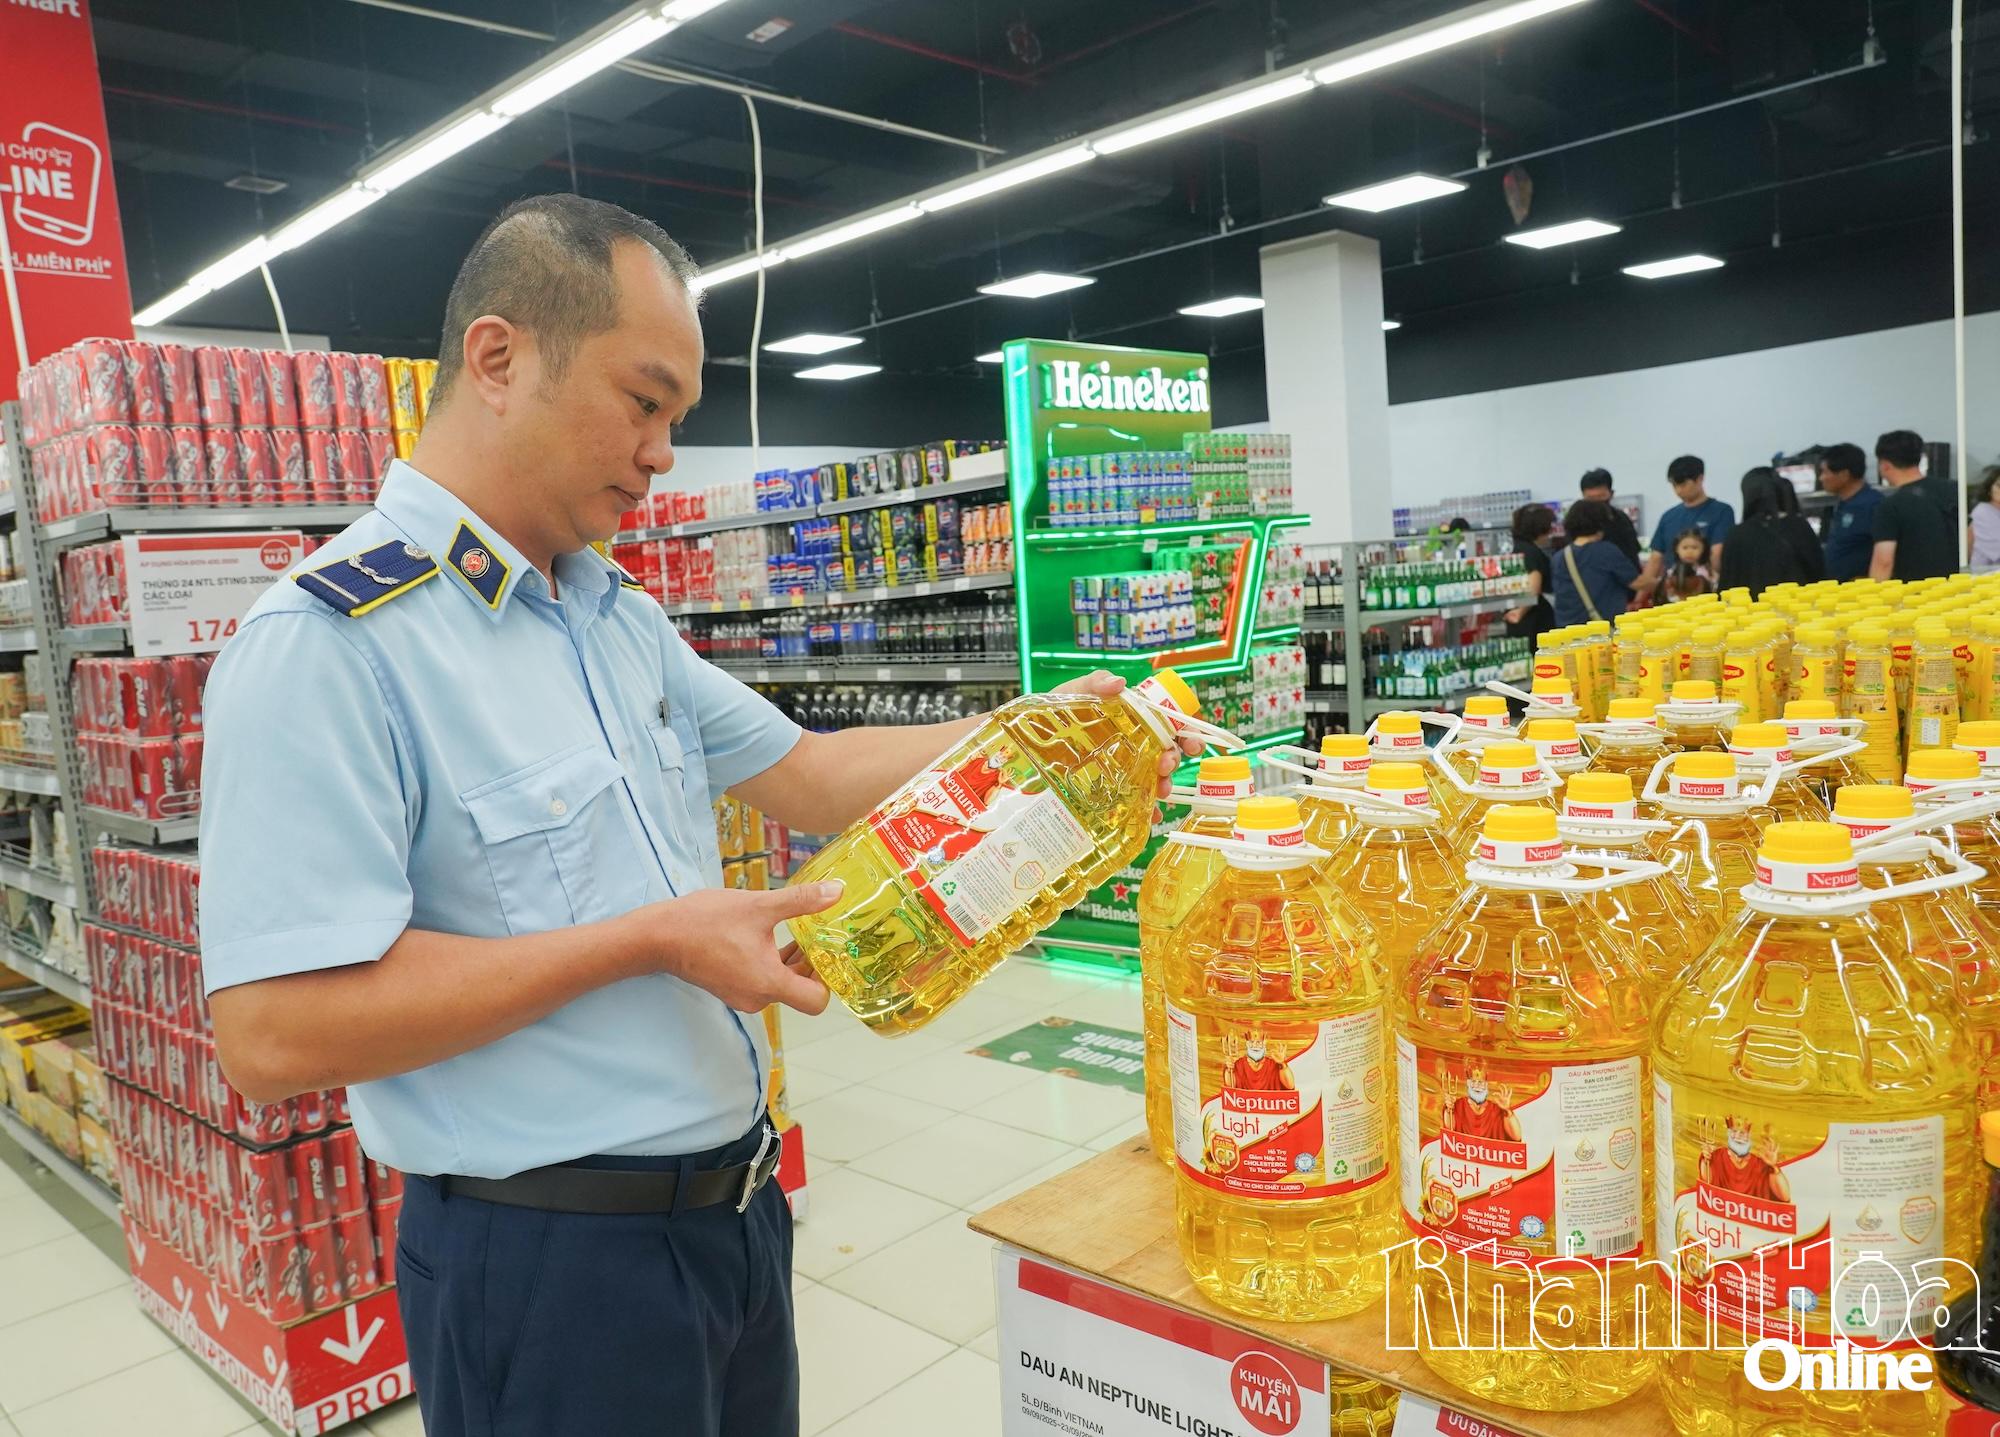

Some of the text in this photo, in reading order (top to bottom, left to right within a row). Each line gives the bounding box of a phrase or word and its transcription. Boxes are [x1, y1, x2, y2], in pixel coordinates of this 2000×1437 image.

[1052, 360, 1210, 412] Heineken
[142, 577, 179, 589] THÙNG
[181, 578, 194, 588] 24
[195, 577, 215, 587] NTL
[216, 575, 248, 586] STING
[142, 588, 166, 600] CÁC
[1202, 785, 1233, 796] Neptune
[1681, 784, 1723, 796] Neptune
[1223, 1090, 1297, 1112] Neptune
[1222, 1112, 1260, 1138] Light
[1441, 1133, 1524, 1165] Neptune
[1243, 1160, 1287, 1168] CHOLESTEROL
[1441, 1157, 1480, 1188] Light
[1699, 1185, 1793, 1228] Neptune
[1461, 1214, 1511, 1230] CHOLESTEROL
[1696, 1212, 1742, 1249] Light
[1020, 1350, 1055, 1378] DAU
[1059, 1367, 1083, 1390] AN
[1087, 1375, 1172, 1425] NEPTUNE
[1239, 1367, 1292, 1397] KHUYẾN
[314, 1368, 416, 1435] PRO
[1240, 1386, 1292, 1425] MÃI
[1062, 1409, 1104, 1435] VIETNAM
[1448, 1411, 1469, 1430] ƯU
